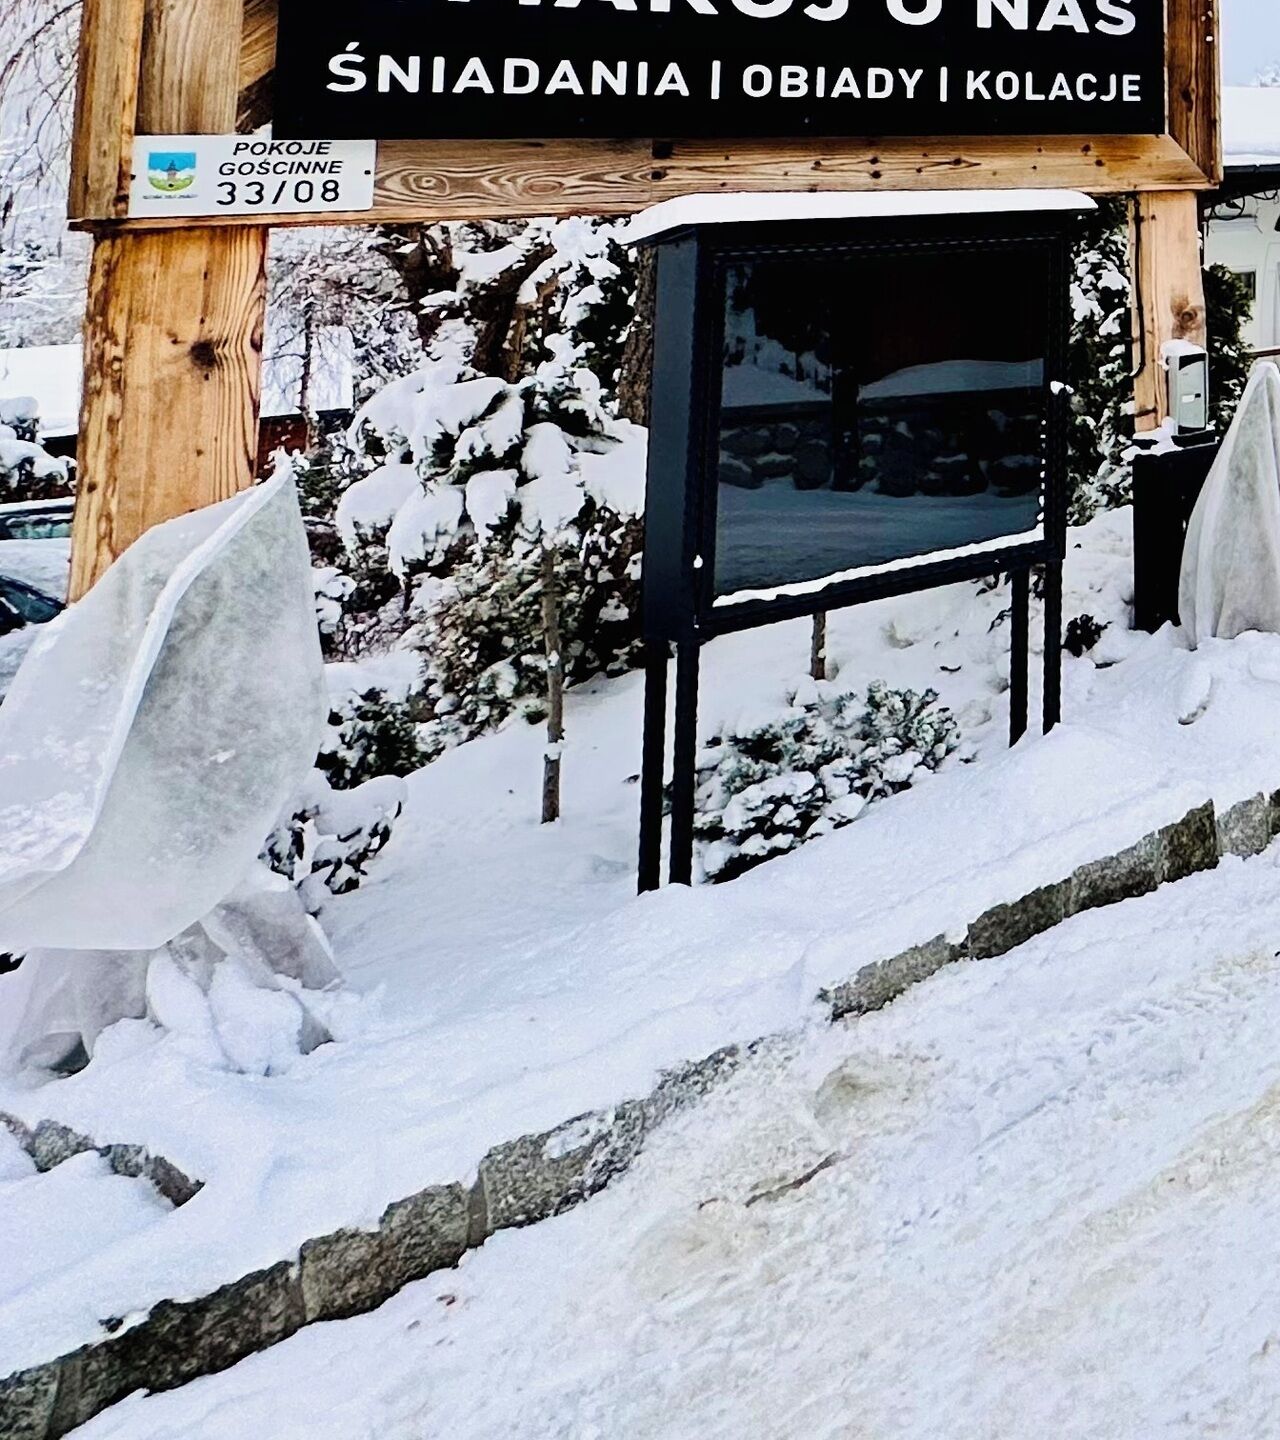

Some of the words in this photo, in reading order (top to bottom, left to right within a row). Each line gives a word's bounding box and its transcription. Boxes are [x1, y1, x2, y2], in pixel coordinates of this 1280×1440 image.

[326, 41, 690, 97] ŚNIADANIA
[742, 64, 924, 99] OBIADY
[966, 70, 1142, 102] KOLACJE
[232, 141, 332, 156] POKOJE
[218, 158, 343, 176] GOŚCINNE
[216, 179, 340, 206] 33/08
